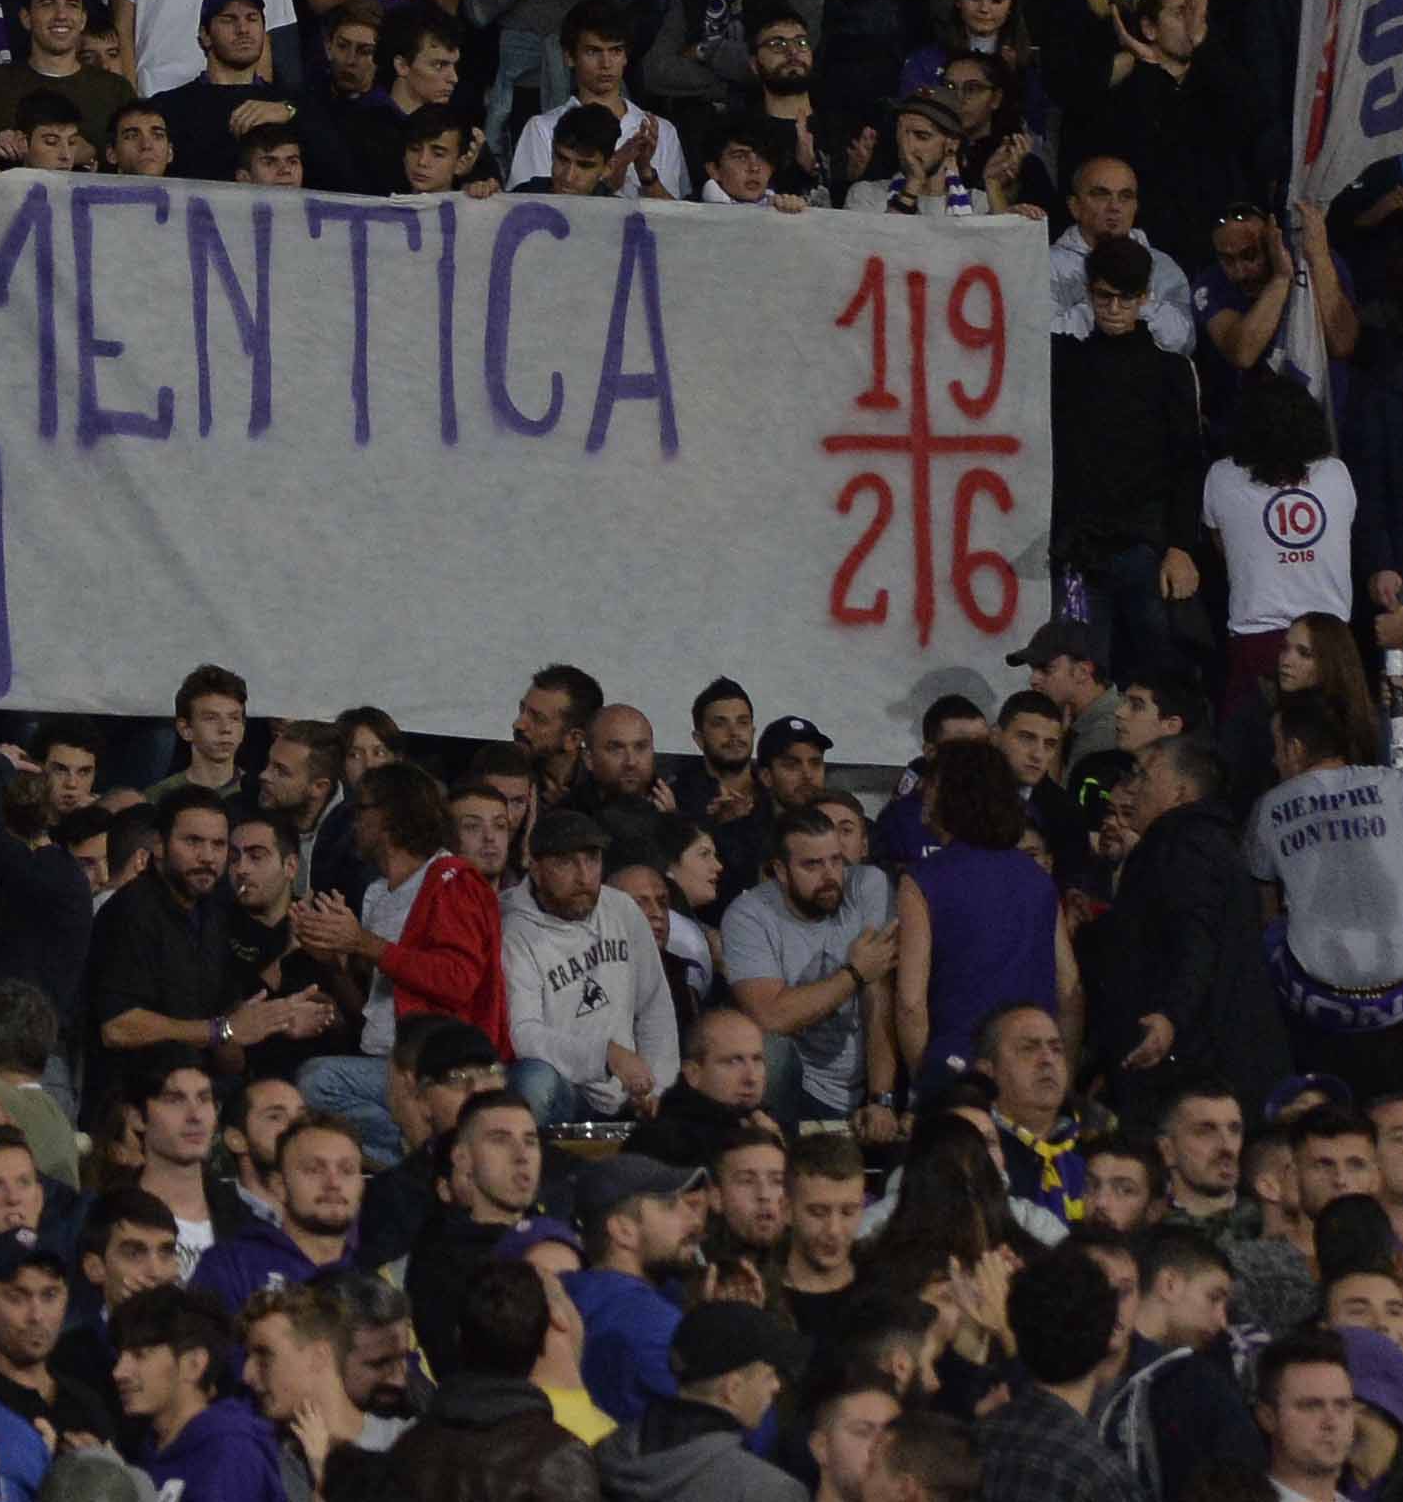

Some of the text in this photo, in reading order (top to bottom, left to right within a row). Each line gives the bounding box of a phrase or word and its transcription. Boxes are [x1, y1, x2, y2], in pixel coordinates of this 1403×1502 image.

[1275, 501, 1315, 535] 10
[1278, 550, 1315, 564] 2018
[1271, 785, 1383, 829] SIEMPRE
[1280, 815, 1386, 858] CONTIGO
